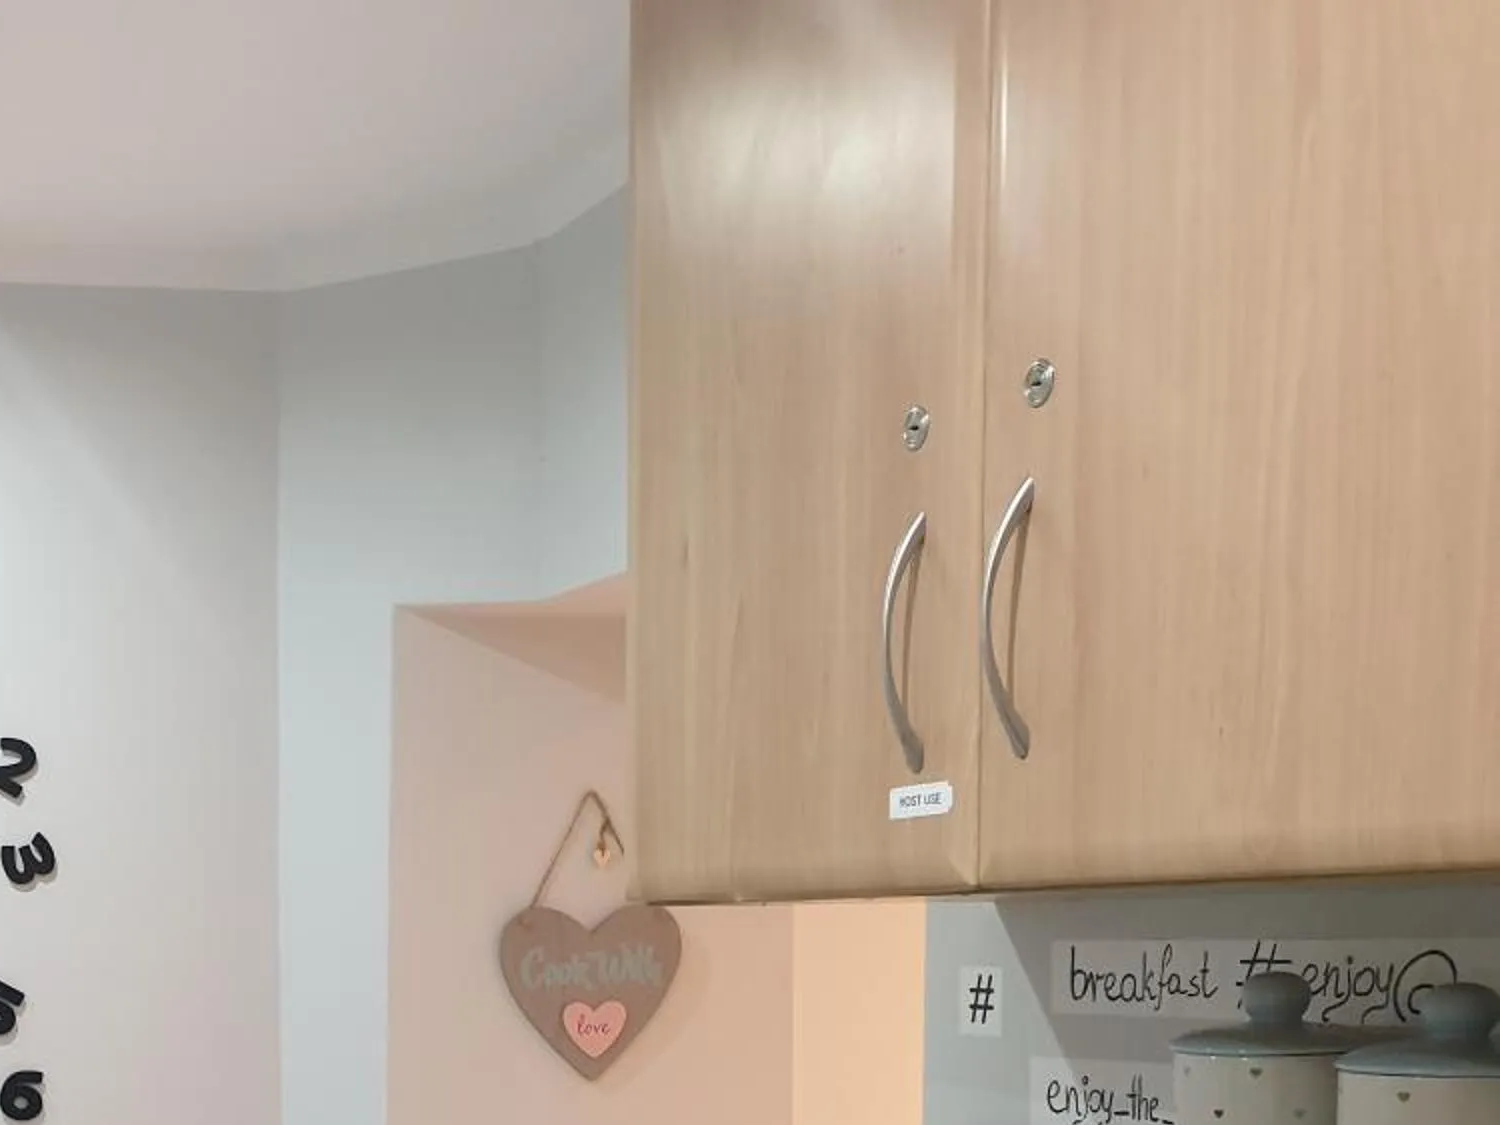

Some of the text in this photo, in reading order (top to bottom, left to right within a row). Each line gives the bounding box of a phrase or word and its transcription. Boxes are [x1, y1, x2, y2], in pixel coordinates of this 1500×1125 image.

[1, 832, 56, 885] 3
[968, 973, 995, 1025] #
[1070, 943, 1219, 1011] breakfast
[0, 1071, 43, 1121] 6
